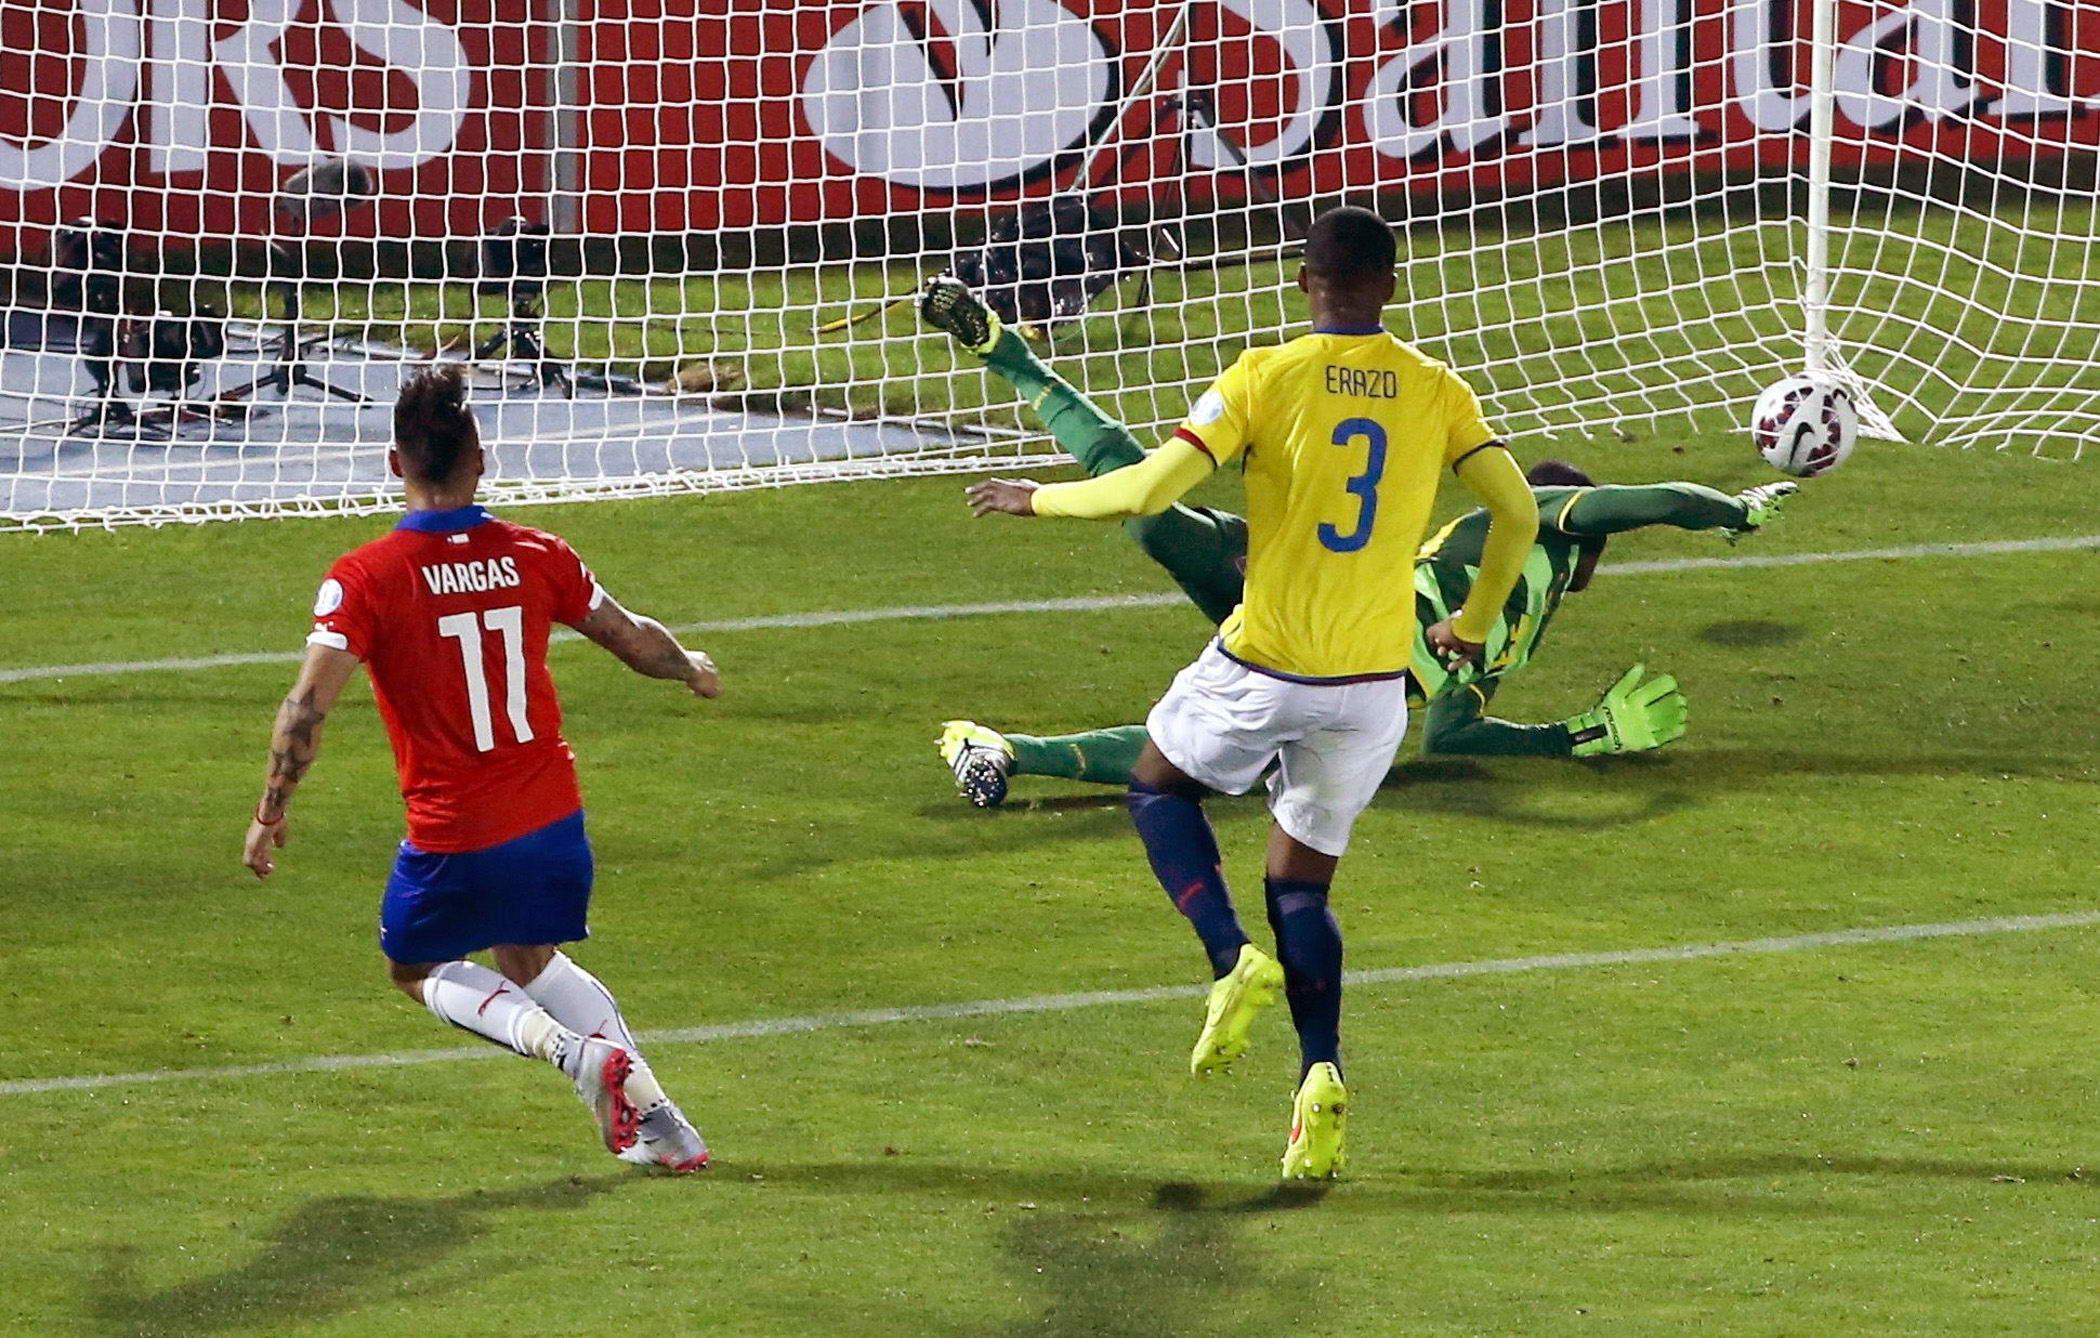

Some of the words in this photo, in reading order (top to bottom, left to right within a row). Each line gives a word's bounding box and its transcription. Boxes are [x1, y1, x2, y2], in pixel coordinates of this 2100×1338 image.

[1325, 364, 1398, 400] ERAZO
[1317, 416, 1388, 553] 3
[421, 556, 522, 595] VARGAS
[437, 605, 535, 753] 11
